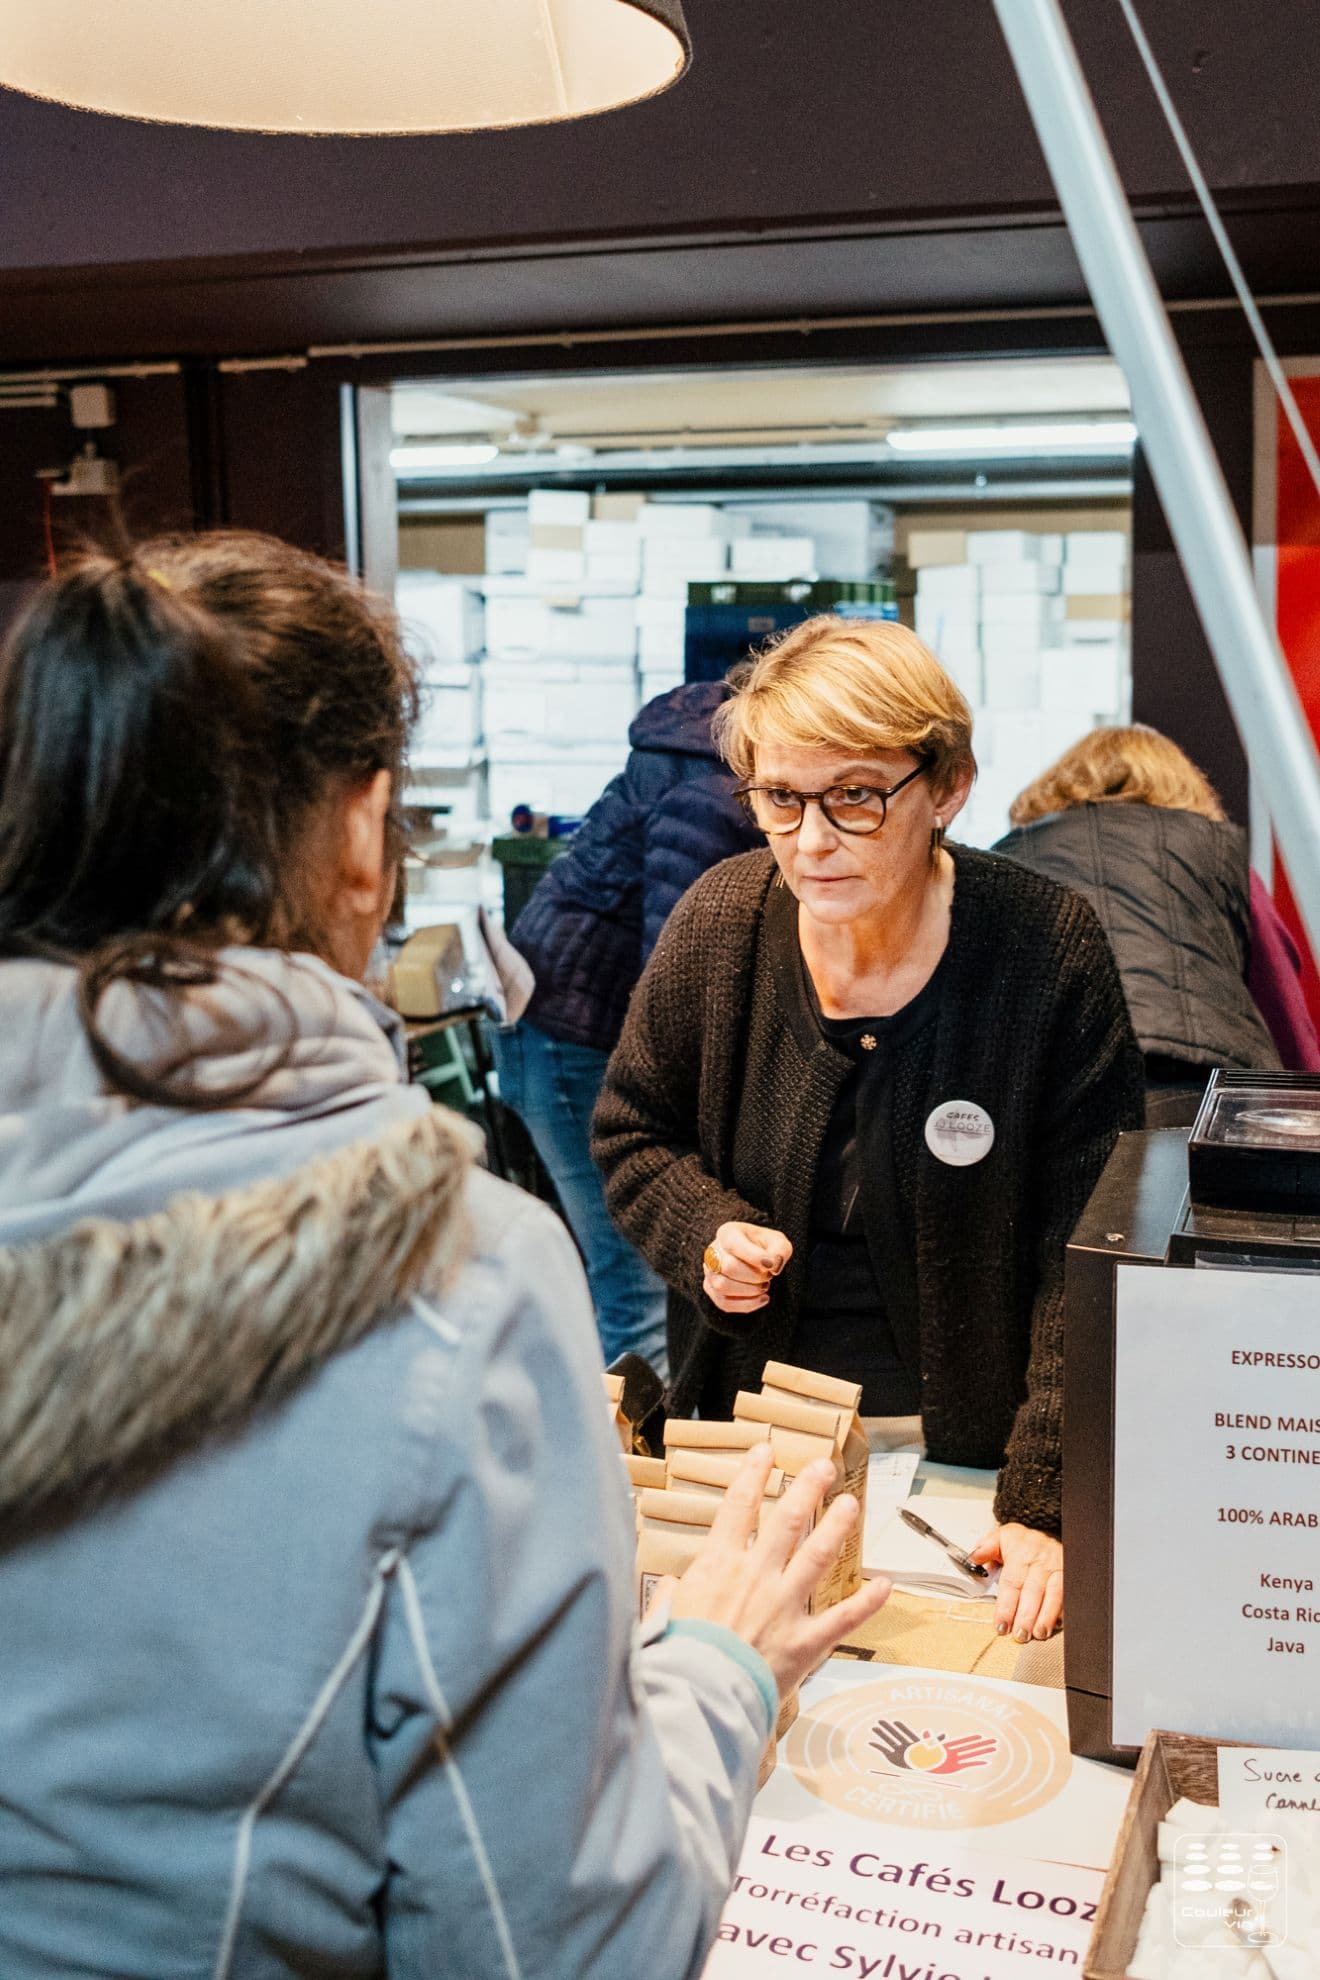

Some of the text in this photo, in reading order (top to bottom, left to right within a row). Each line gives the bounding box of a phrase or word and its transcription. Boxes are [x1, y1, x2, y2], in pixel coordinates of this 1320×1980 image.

[1231, 1350, 1320, 1370] EXPRESSO
[1214, 1413, 1271, 1430] BLEND
[1226, 1445, 1320, 1465] 3 CONTINE
[1217, 1508, 1319, 1529] 100% ARAB
[1260, 1573, 1313, 1593] Kenya
[1242, 1603, 1320, 1623] Costa Ric
[1266, 1636, 1305, 1654] Java
[1244, 1758, 1302, 1782] Sucre
[760, 1834, 1099, 1922] Les Cafés Looz
[732, 1875, 1079, 1965] Torréfaction artisan
[716, 1922, 818, 1962] avec
